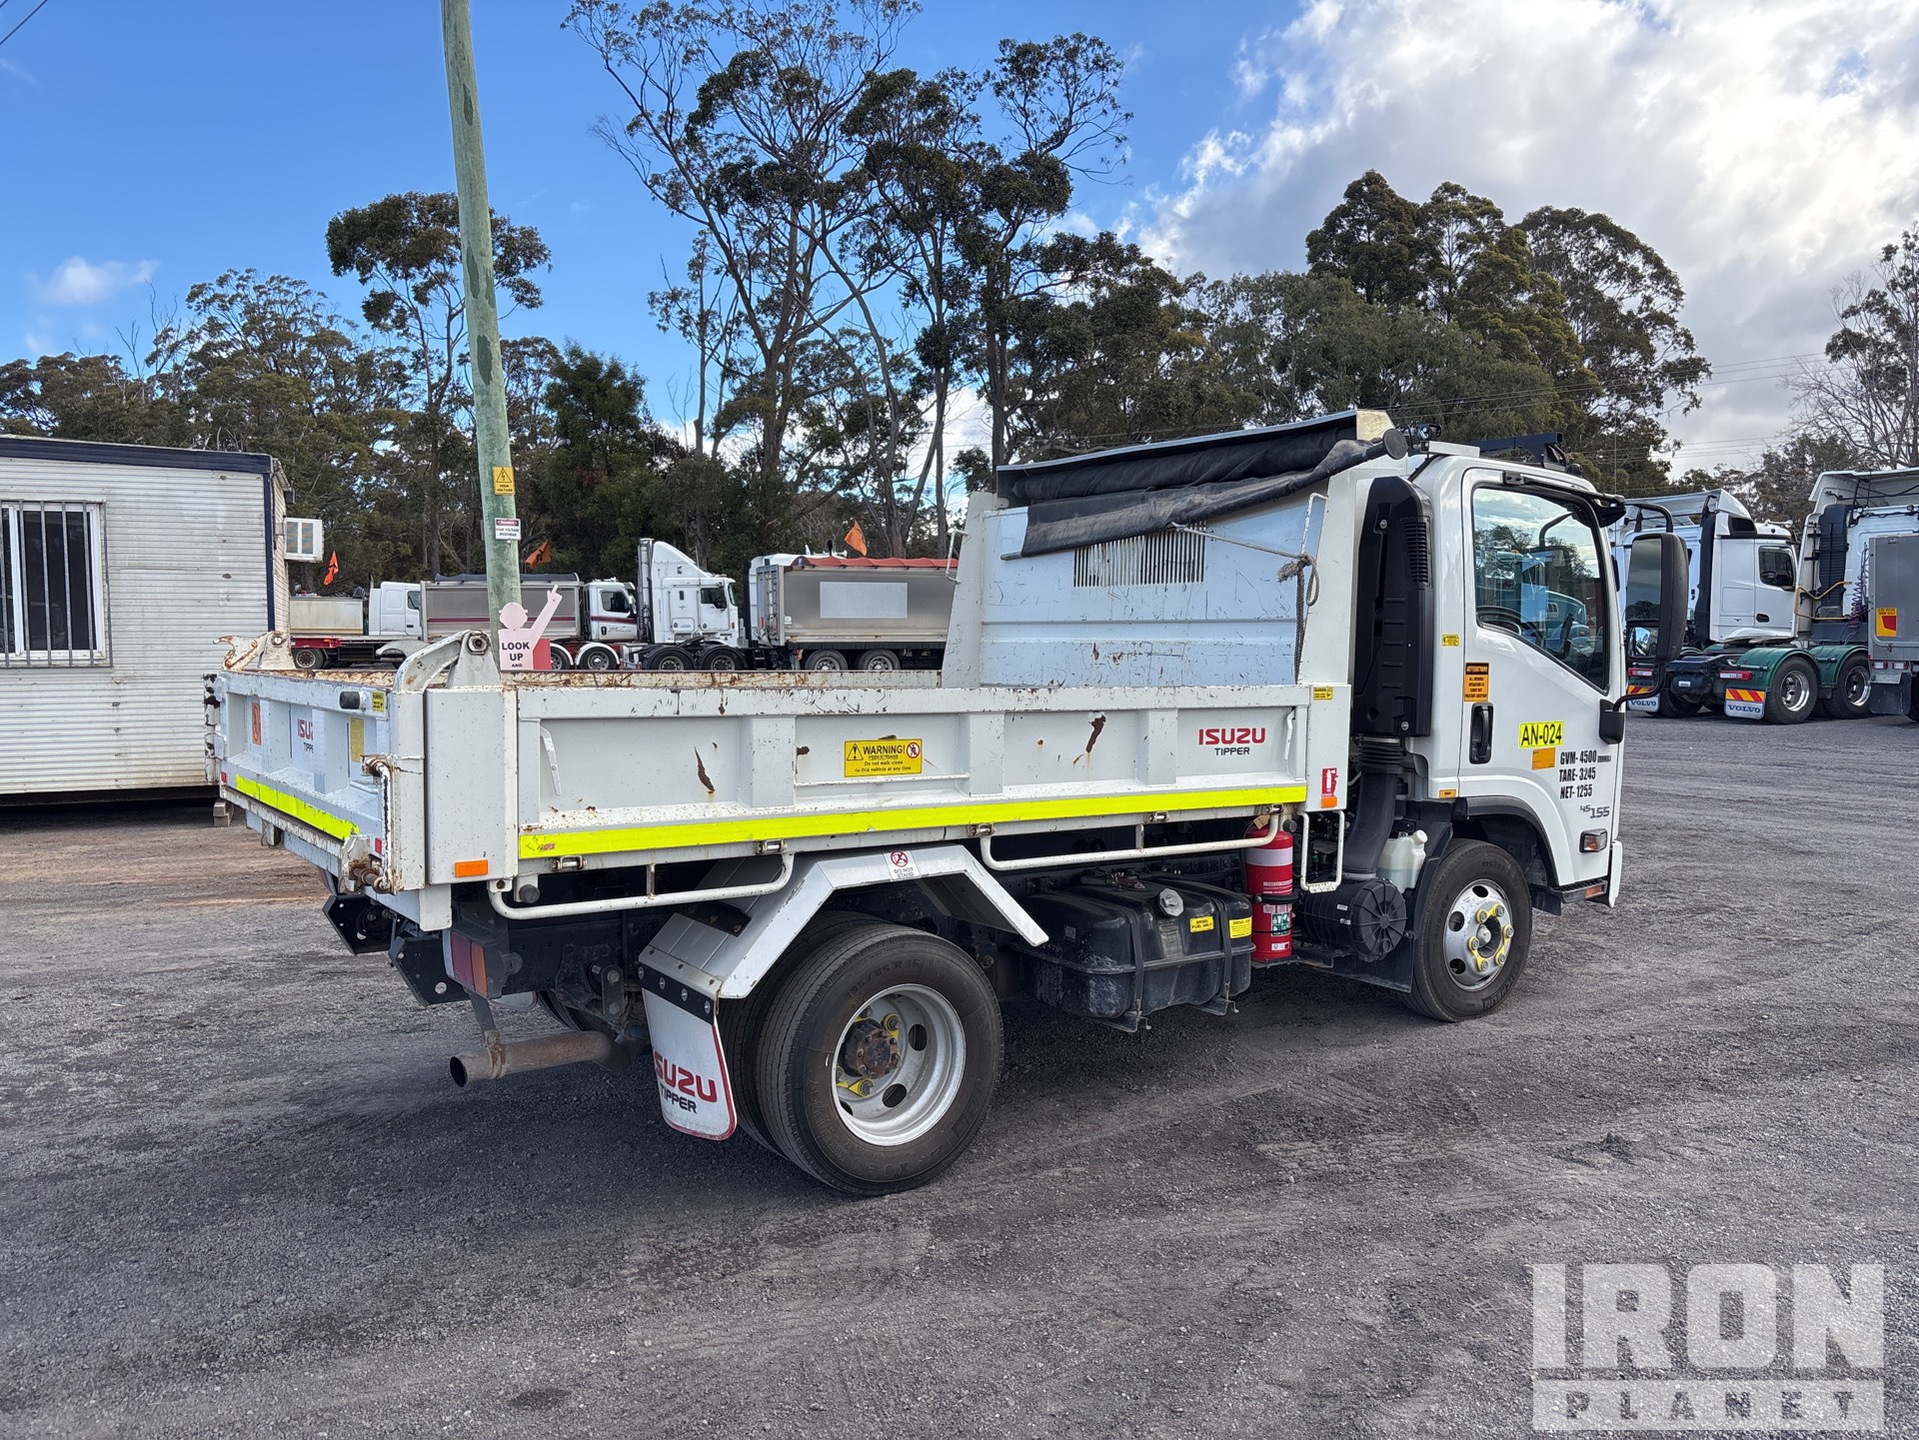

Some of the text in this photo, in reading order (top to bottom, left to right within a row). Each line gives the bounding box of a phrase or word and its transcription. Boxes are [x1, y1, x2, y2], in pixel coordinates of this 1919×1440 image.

[501, 642, 530, 650] LOOK
[509, 653, 523, 661] UP
[1728, 704, 1761, 714] VOLVO
[1198, 727, 1266, 746] ISUZU
[1521, 723, 1562, 746] AN-024
[863, 744, 906, 755] WARNING!
[1214, 746, 1251, 756] TIPPER
[1560, 751, 1578, 765] GVM-
[1579, 750, 1597, 763] 4500
[1559, 767, 1596, 782] TARE- 3245
[1560, 784, 1593, 799] NET- 1255
[660, 1083, 698, 1114] TIPPER
